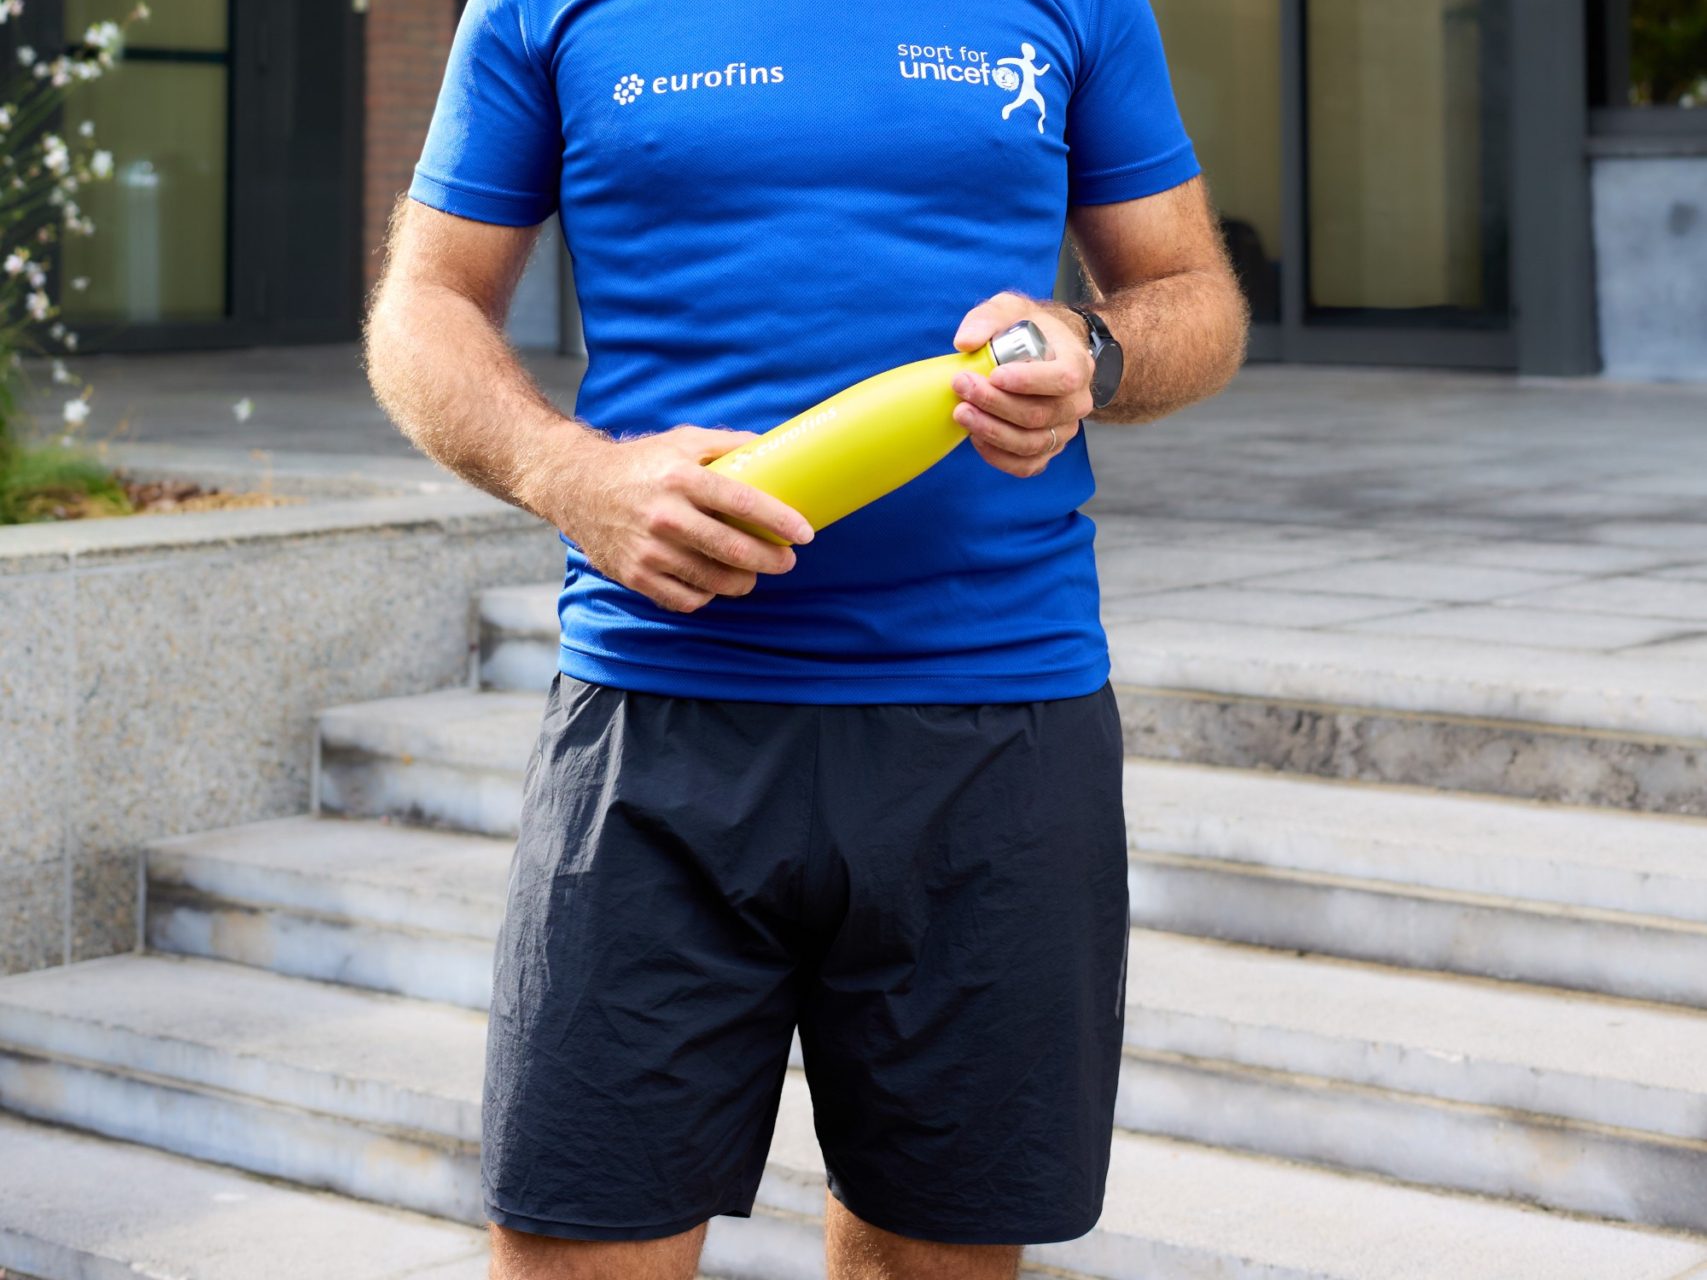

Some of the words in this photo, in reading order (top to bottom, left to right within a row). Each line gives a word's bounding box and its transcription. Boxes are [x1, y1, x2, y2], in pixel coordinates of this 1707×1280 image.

[897, 43, 954, 60] sport
[959, 46, 988, 63] for
[652, 62, 784, 94] eurofins
[899, 57, 991, 86] unicef
